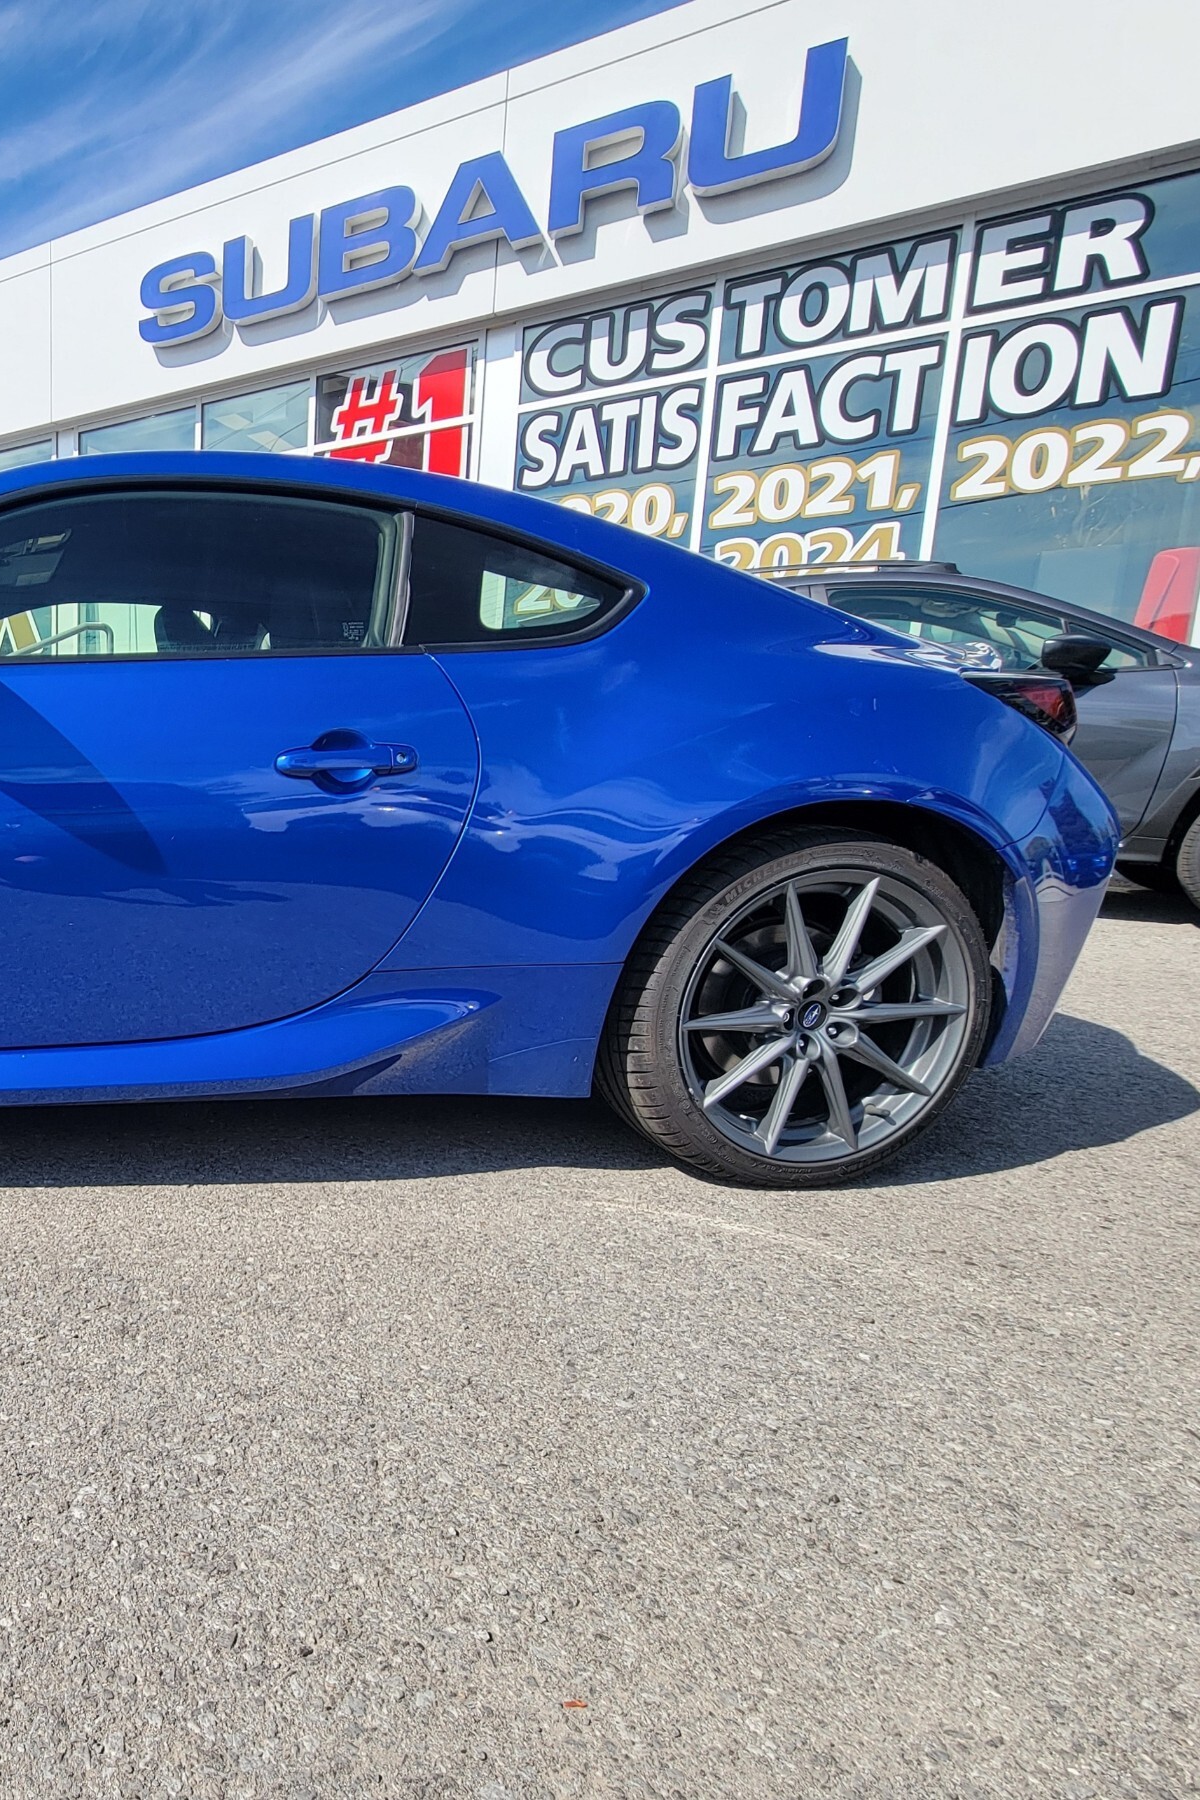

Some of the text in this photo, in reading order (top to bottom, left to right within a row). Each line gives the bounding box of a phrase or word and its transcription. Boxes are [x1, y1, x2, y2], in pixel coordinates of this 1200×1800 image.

[138, 36, 849, 346] SUBARU
[709, 449, 921, 529] 2021,
[951, 409, 1200, 500] 2022,
